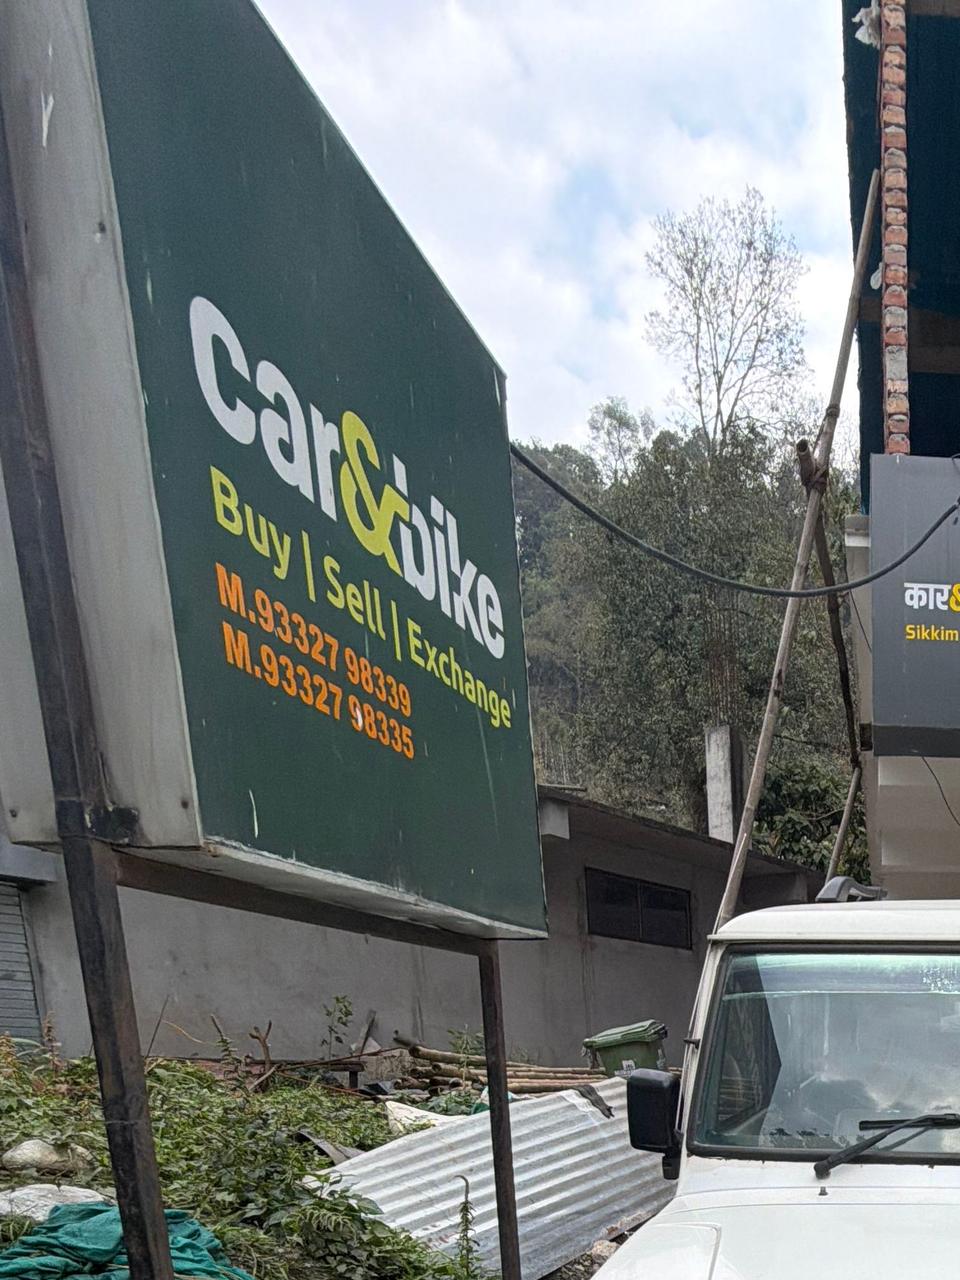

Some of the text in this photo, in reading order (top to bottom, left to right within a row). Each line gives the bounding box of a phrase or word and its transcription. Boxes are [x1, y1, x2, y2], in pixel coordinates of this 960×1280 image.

[189, 296, 505, 659] car&bike
[210, 465, 292, 581] Buy
[323, 555, 386, 641] Sell
[407, 617, 512, 729] Exchange
[215, 562, 412, 718] M.93327 98339
[905, 624, 960, 641] Sikkim
[222, 621, 415, 760] M.93327 98335
